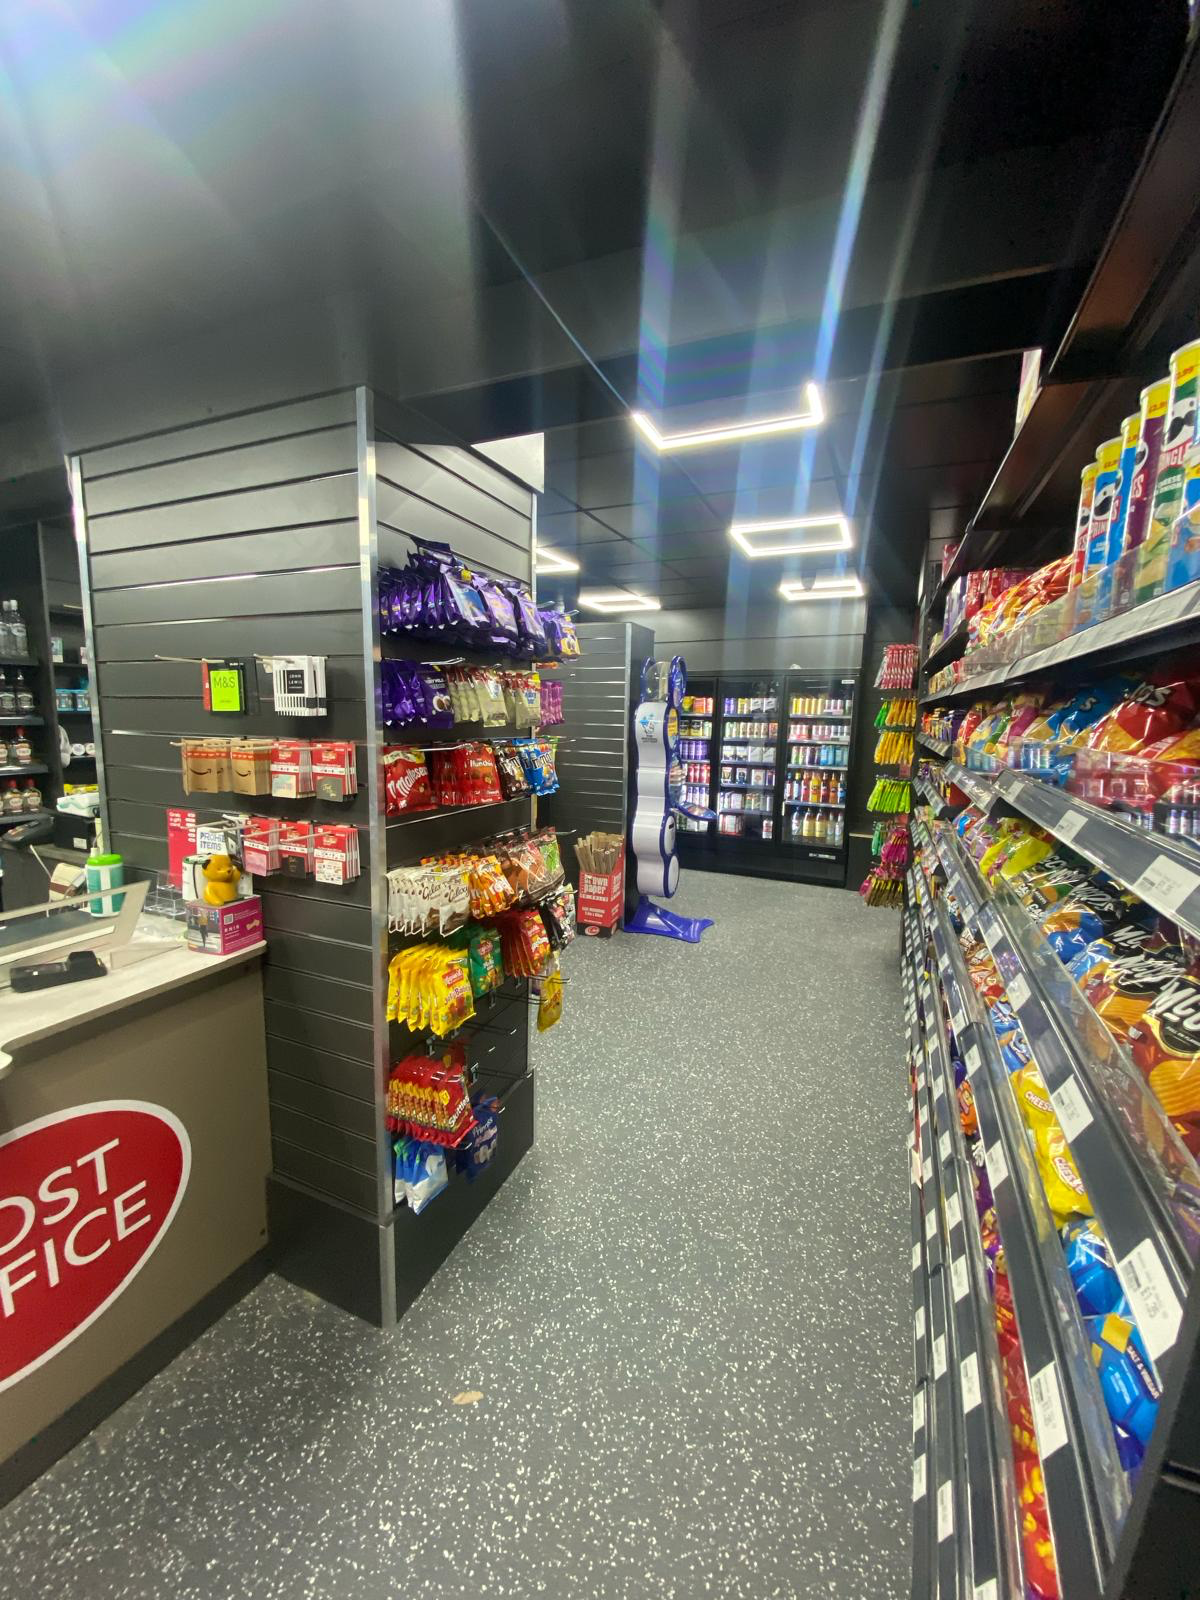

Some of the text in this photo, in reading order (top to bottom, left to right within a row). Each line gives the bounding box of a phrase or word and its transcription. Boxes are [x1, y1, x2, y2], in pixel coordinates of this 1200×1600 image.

[213, 676, 235, 689] M&S
[200, 841, 221, 851] ITEMS
[448, 1095, 469, 1127] Skittles
[1126, 1344, 1139, 1362] SALT
